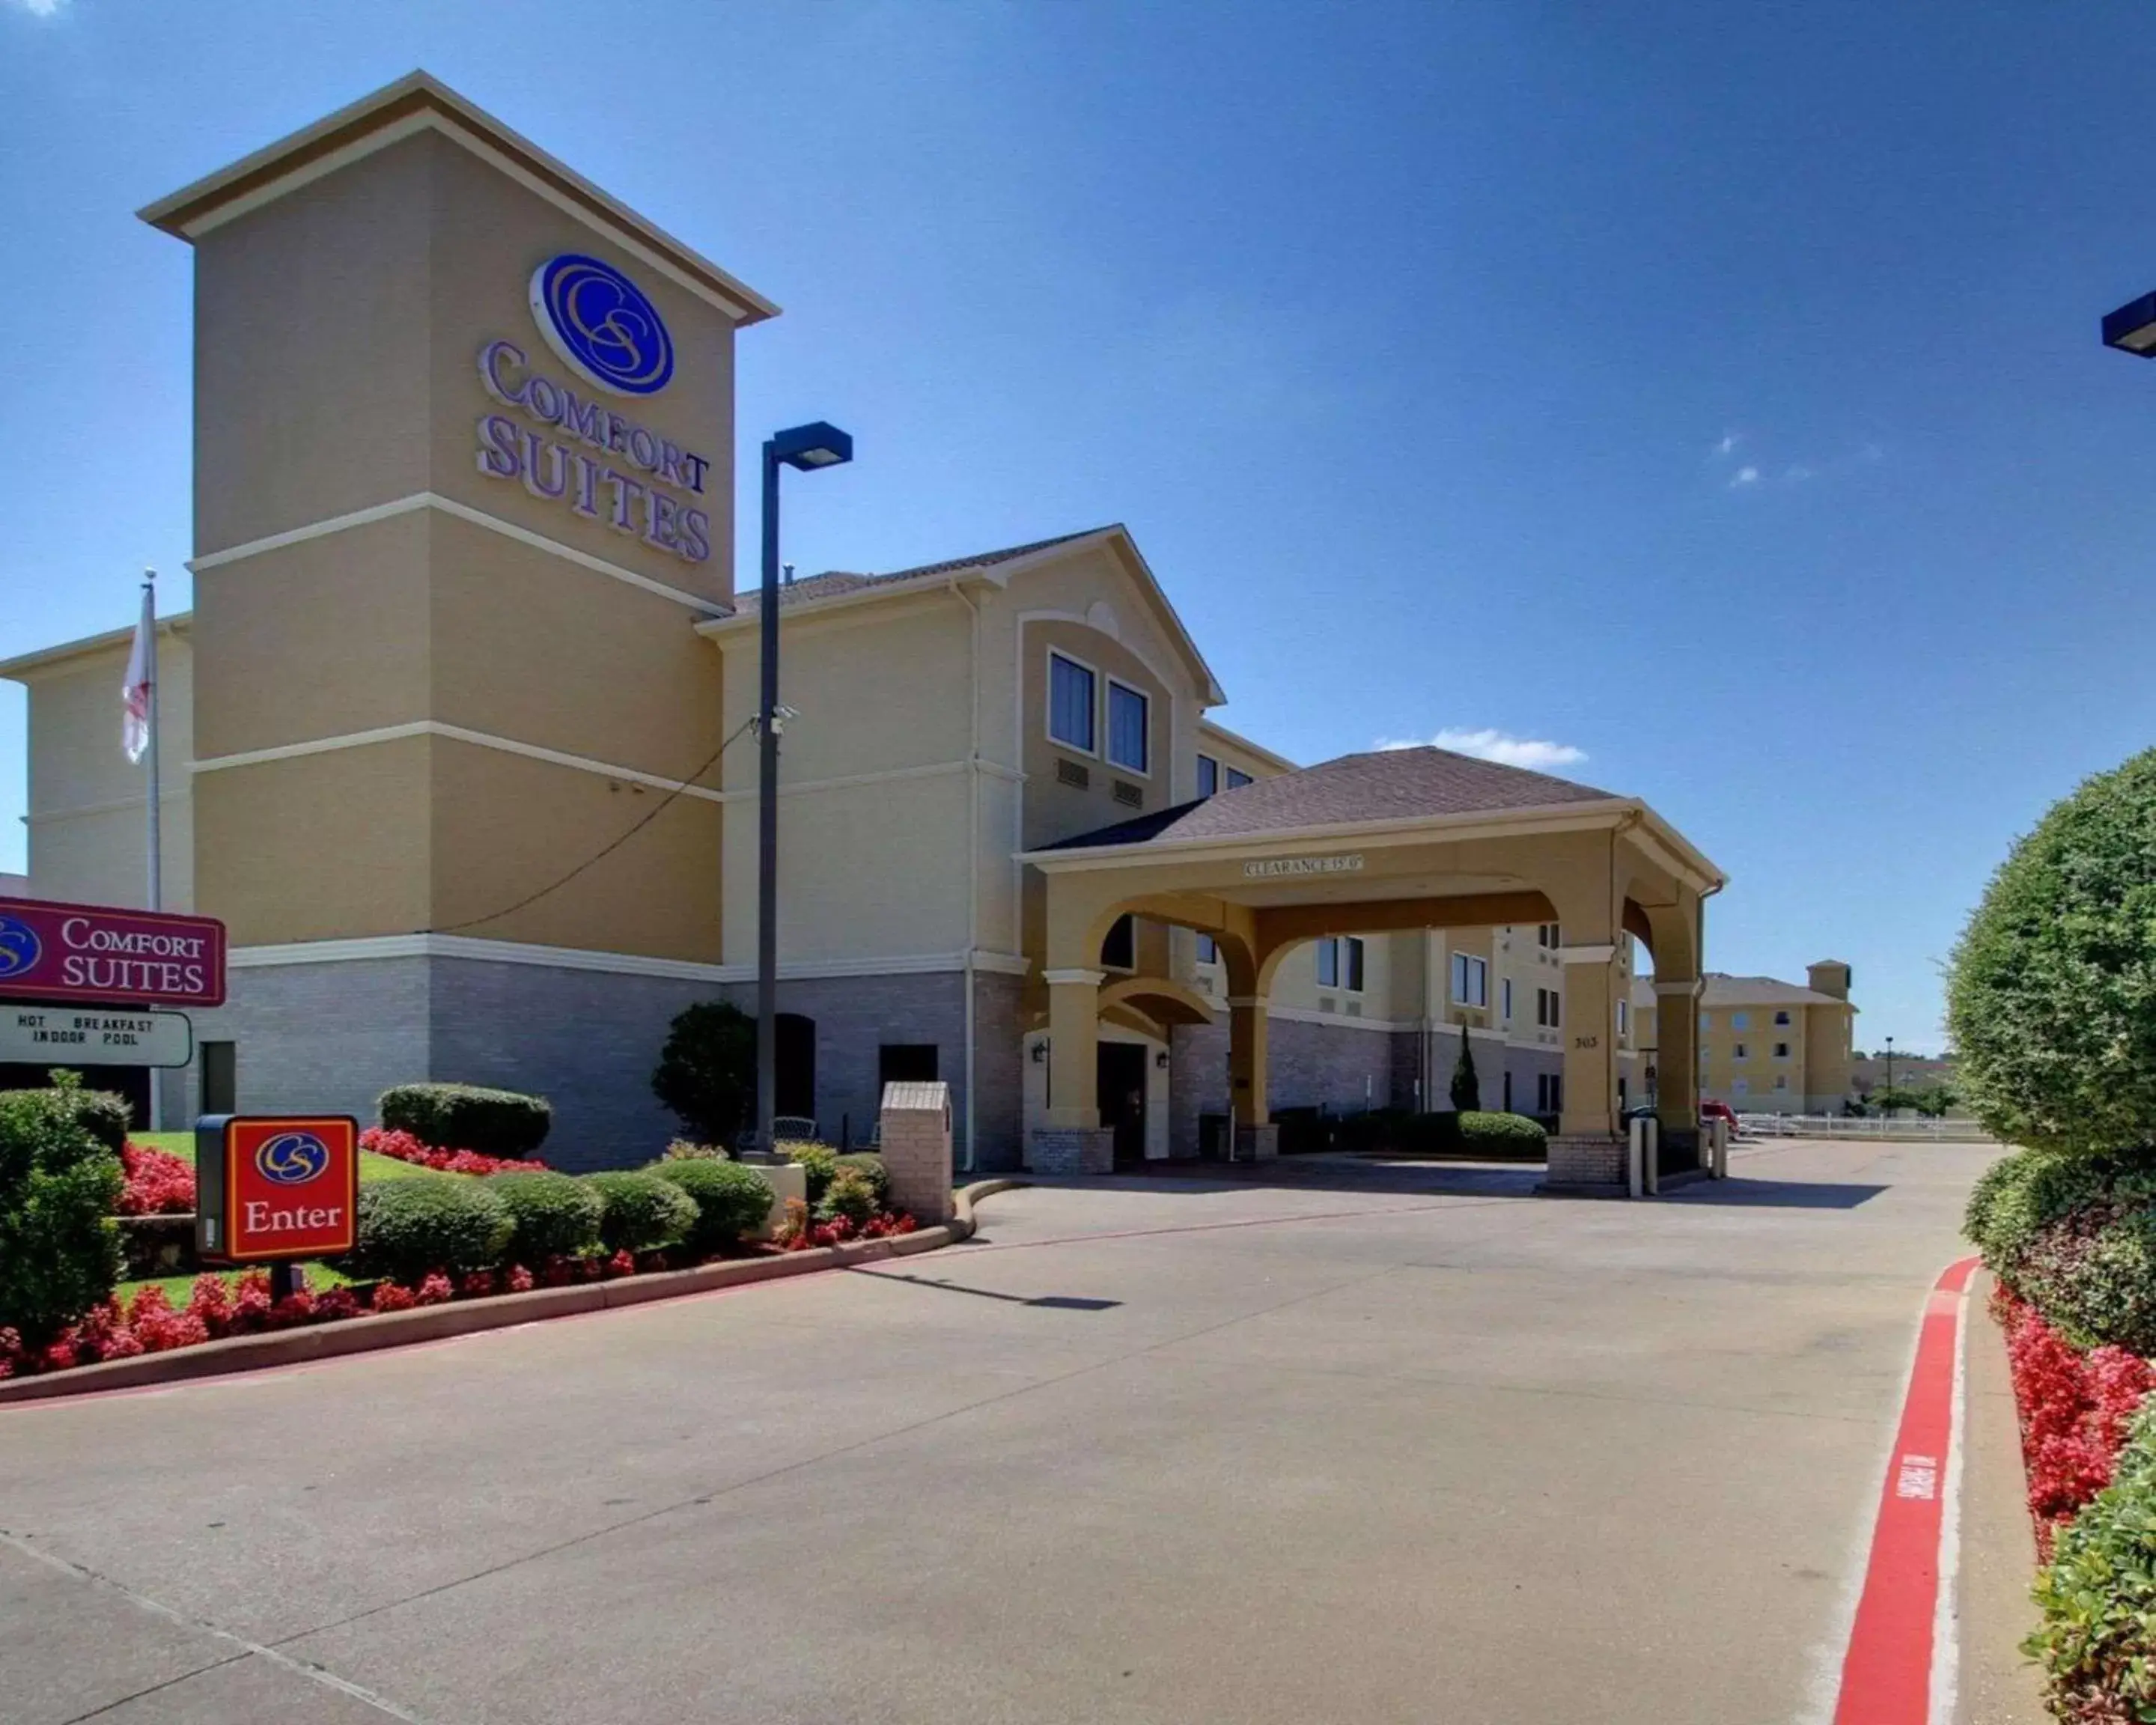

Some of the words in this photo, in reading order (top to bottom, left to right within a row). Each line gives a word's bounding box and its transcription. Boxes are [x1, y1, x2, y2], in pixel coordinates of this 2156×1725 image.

[477, 415, 710, 562] SUITES
[61, 918, 205, 958] COMFORT
[61, 956, 204, 994] SUITES
[18, 1015, 46, 1026] HOT
[73, 1017, 153, 1032] BREAKFAST
[33, 1031, 86, 1043] INDOOR
[103, 1032, 138, 1045] POOL
[244, 1201, 342, 1233] Enter
